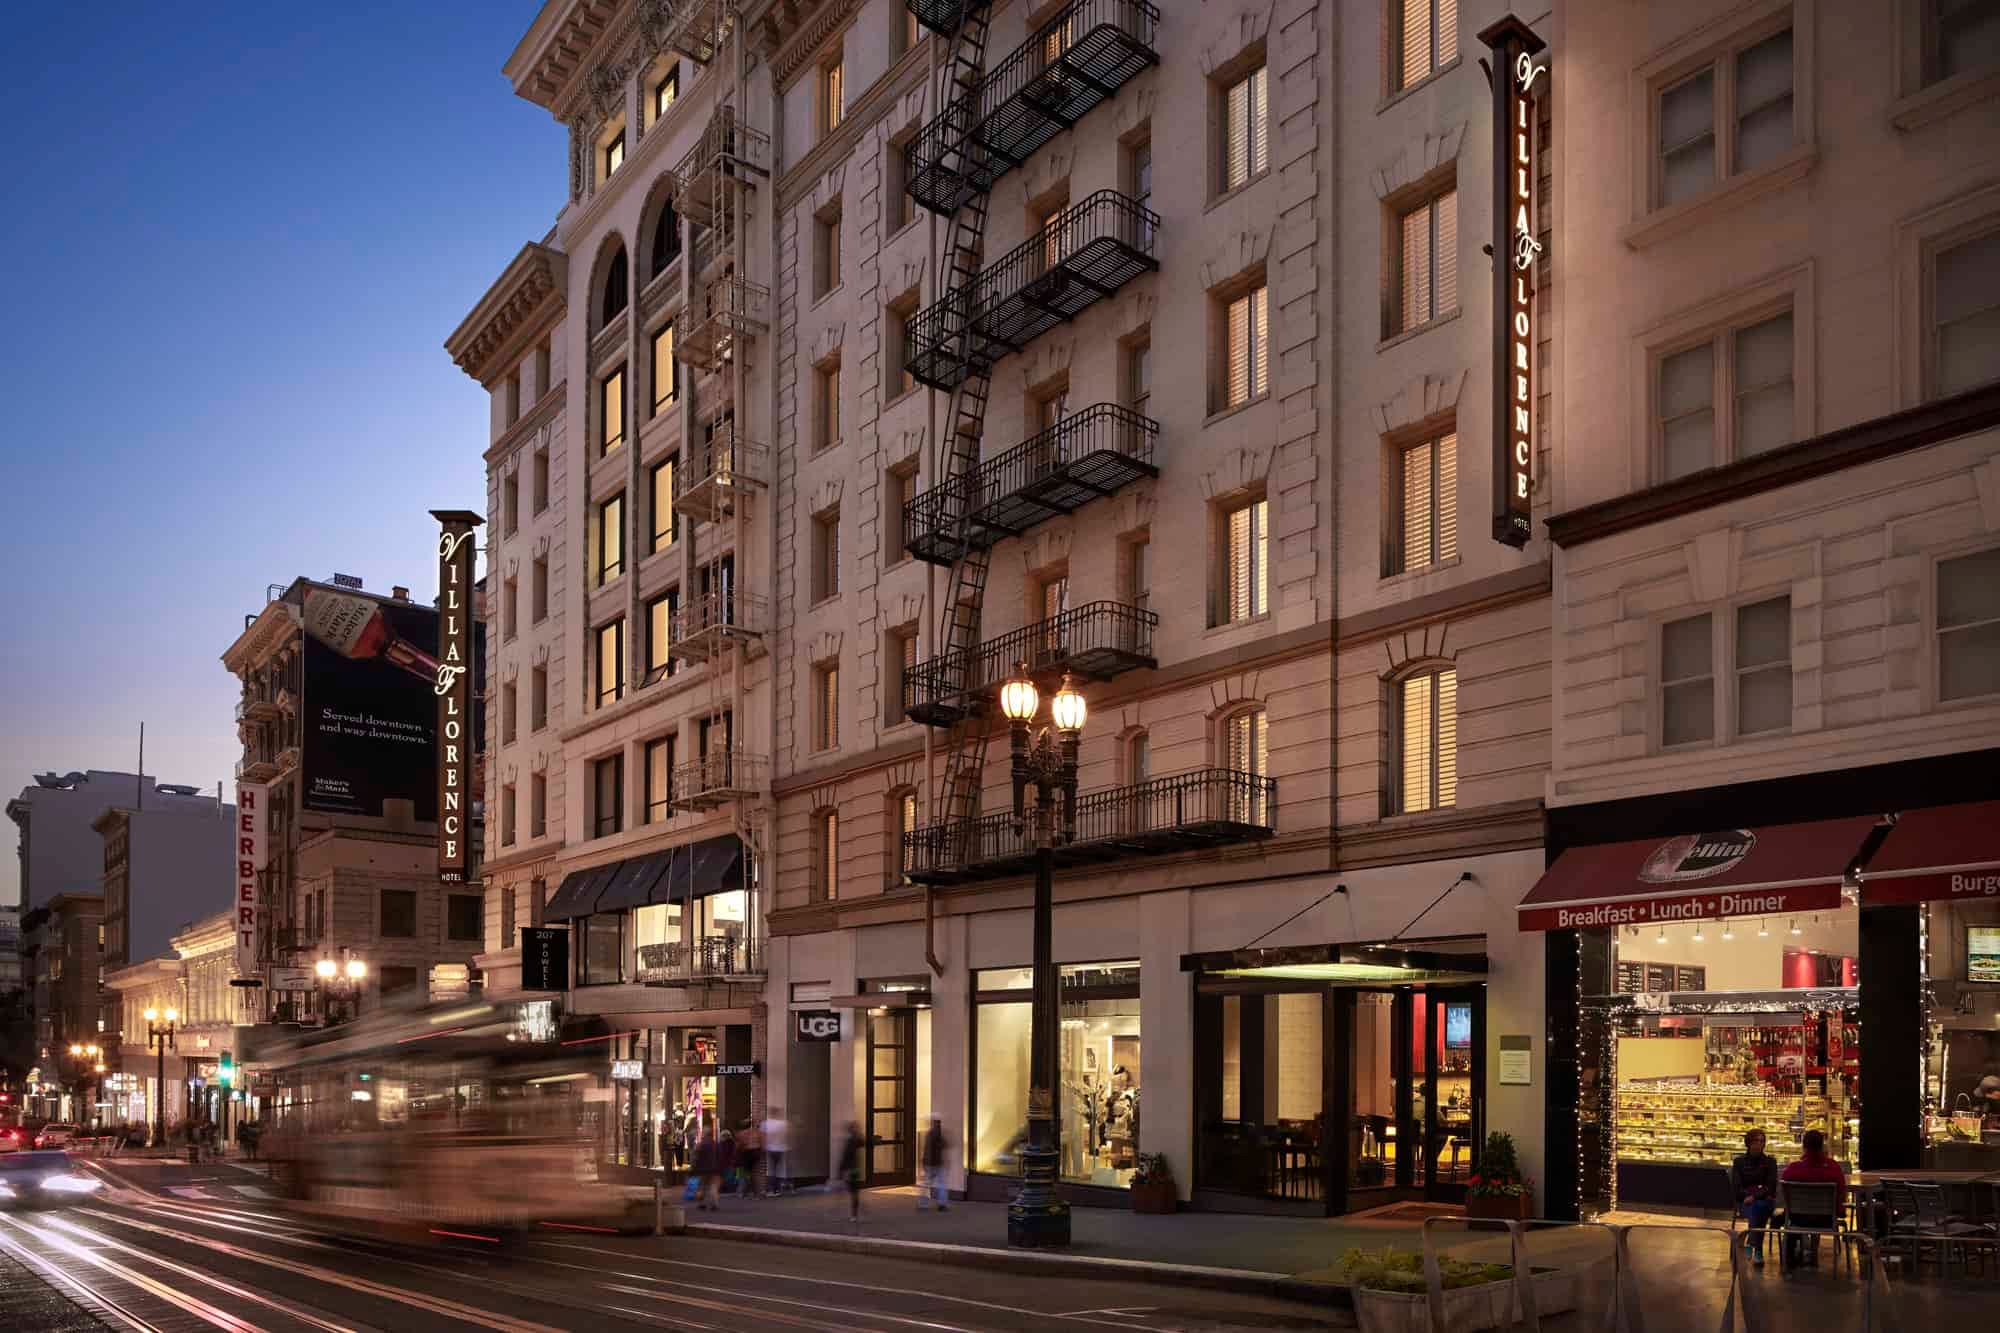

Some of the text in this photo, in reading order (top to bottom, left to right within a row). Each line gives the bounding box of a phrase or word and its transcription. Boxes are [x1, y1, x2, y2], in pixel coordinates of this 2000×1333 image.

[1515, 52, 1546, 499] VILLA FLORENCE
[434, 532, 473, 859] VILLA FLORENCE
[322, 707, 422, 732] Served downtown
[319, 721, 428, 744] and way downtown.
[325, 784, 349, 793] Mark
[239, 791, 254, 947] HERBERT
[441, 873, 461, 881] HOTEL
[1951, 874, 2000, 895] Burg
[1558, 894, 1786, 928] Breakfast Lunch Dinner
[536, 931, 554, 940] 207
[541, 942, 550, 989] POWELL
[800, 1016, 839, 1037] UGG
